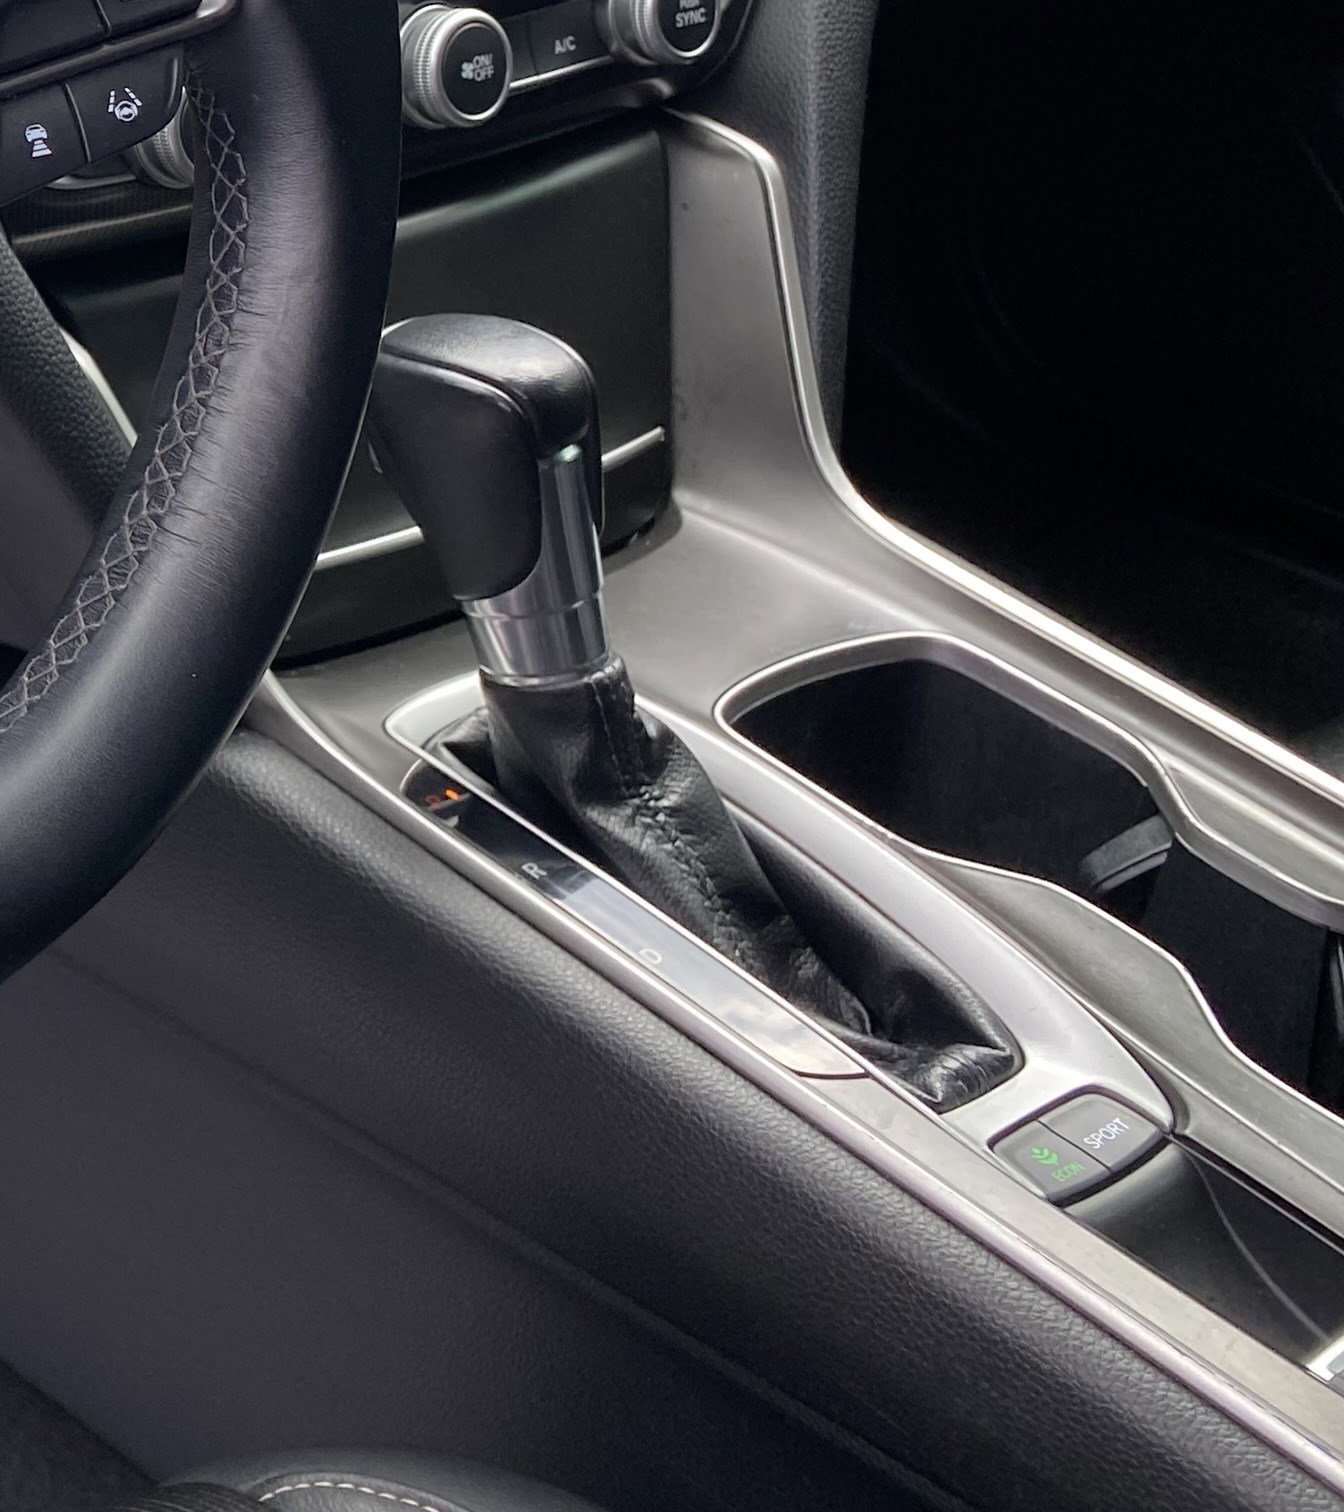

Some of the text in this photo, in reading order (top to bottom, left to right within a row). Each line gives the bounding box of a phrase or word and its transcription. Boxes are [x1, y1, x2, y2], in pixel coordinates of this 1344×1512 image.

[675, 6, 707, 29] SYNC
[554, 35, 577, 55] A/C
[474, 67, 495, 82] OFF
[1083, 1116, 1130, 1150] SPORT
[1052, 1160, 1085, 1182] ECON
